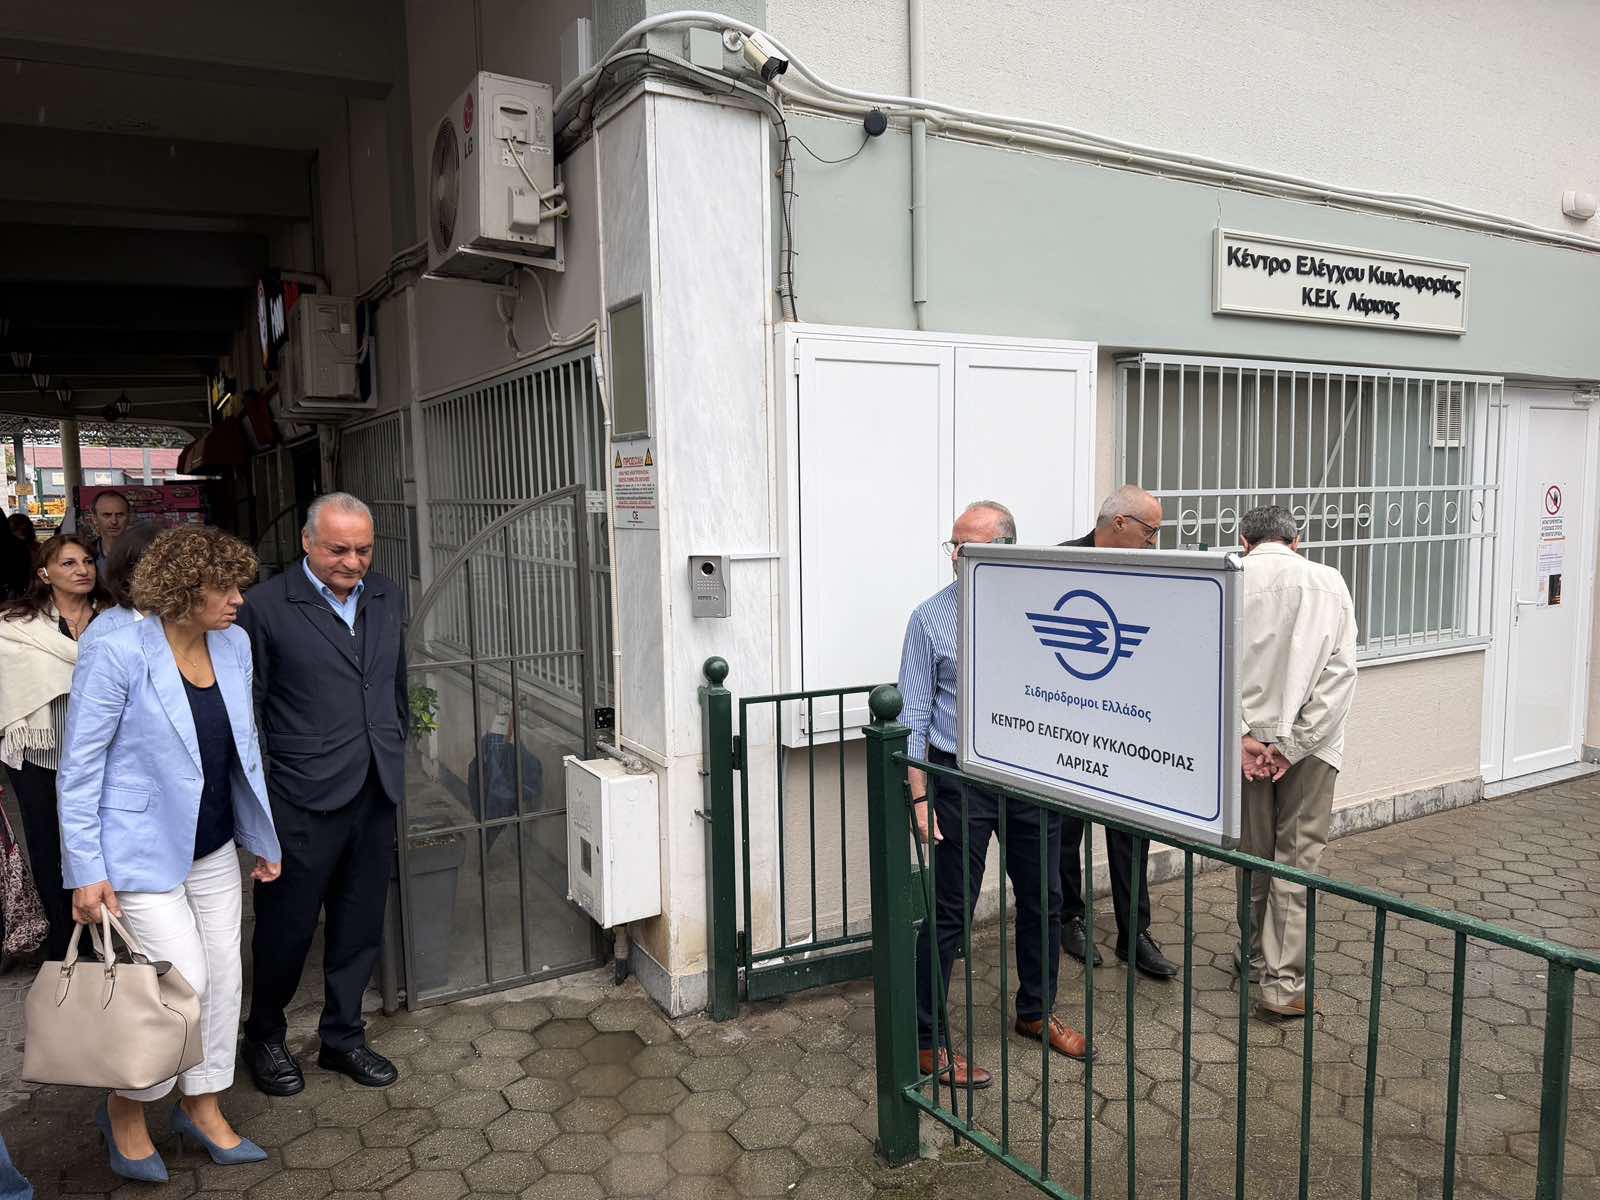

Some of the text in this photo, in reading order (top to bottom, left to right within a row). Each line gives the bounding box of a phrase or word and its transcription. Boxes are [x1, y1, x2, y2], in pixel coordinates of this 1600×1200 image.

[464, 137, 473, 159] LG
[1228, 246, 1461, 298] Κέντρο Ελέγχου Κυκλοφορίας
[1347, 292, 1400, 320] Λάρισας
[1024, 685, 1152, 722] Σιδηρόδρομοι Ελλάδος
[991, 713, 1195, 772] ΚΕΝΤΡΟ ΕΛΕΓΧΟΥ ΚΥΚΛΟΦΟΡΙΑΣ
[1056, 754, 1110, 777] ΛΑΡΙΣΑΣ
